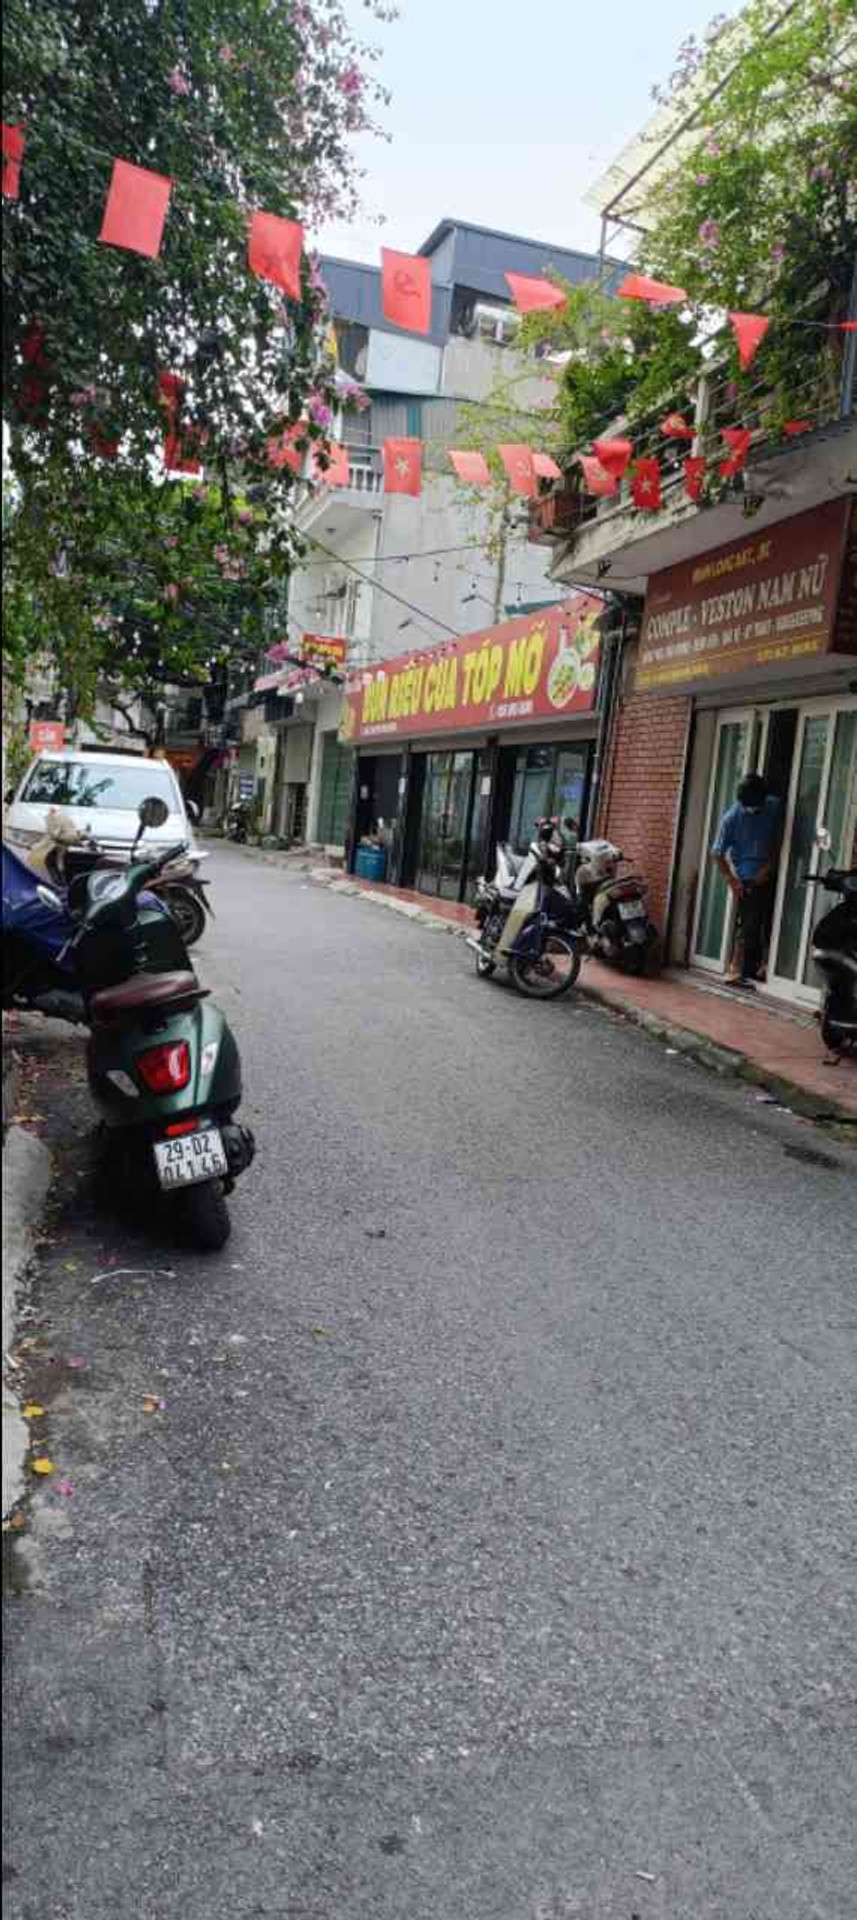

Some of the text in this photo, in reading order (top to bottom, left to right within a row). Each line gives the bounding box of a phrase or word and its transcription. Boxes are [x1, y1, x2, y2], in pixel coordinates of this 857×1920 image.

[701, 586, 756, 625] VESTON
[756, 572, 793, 610] NAM
[462, 638, 504, 706] TÓP
[504, 618, 551, 696] MỠ
